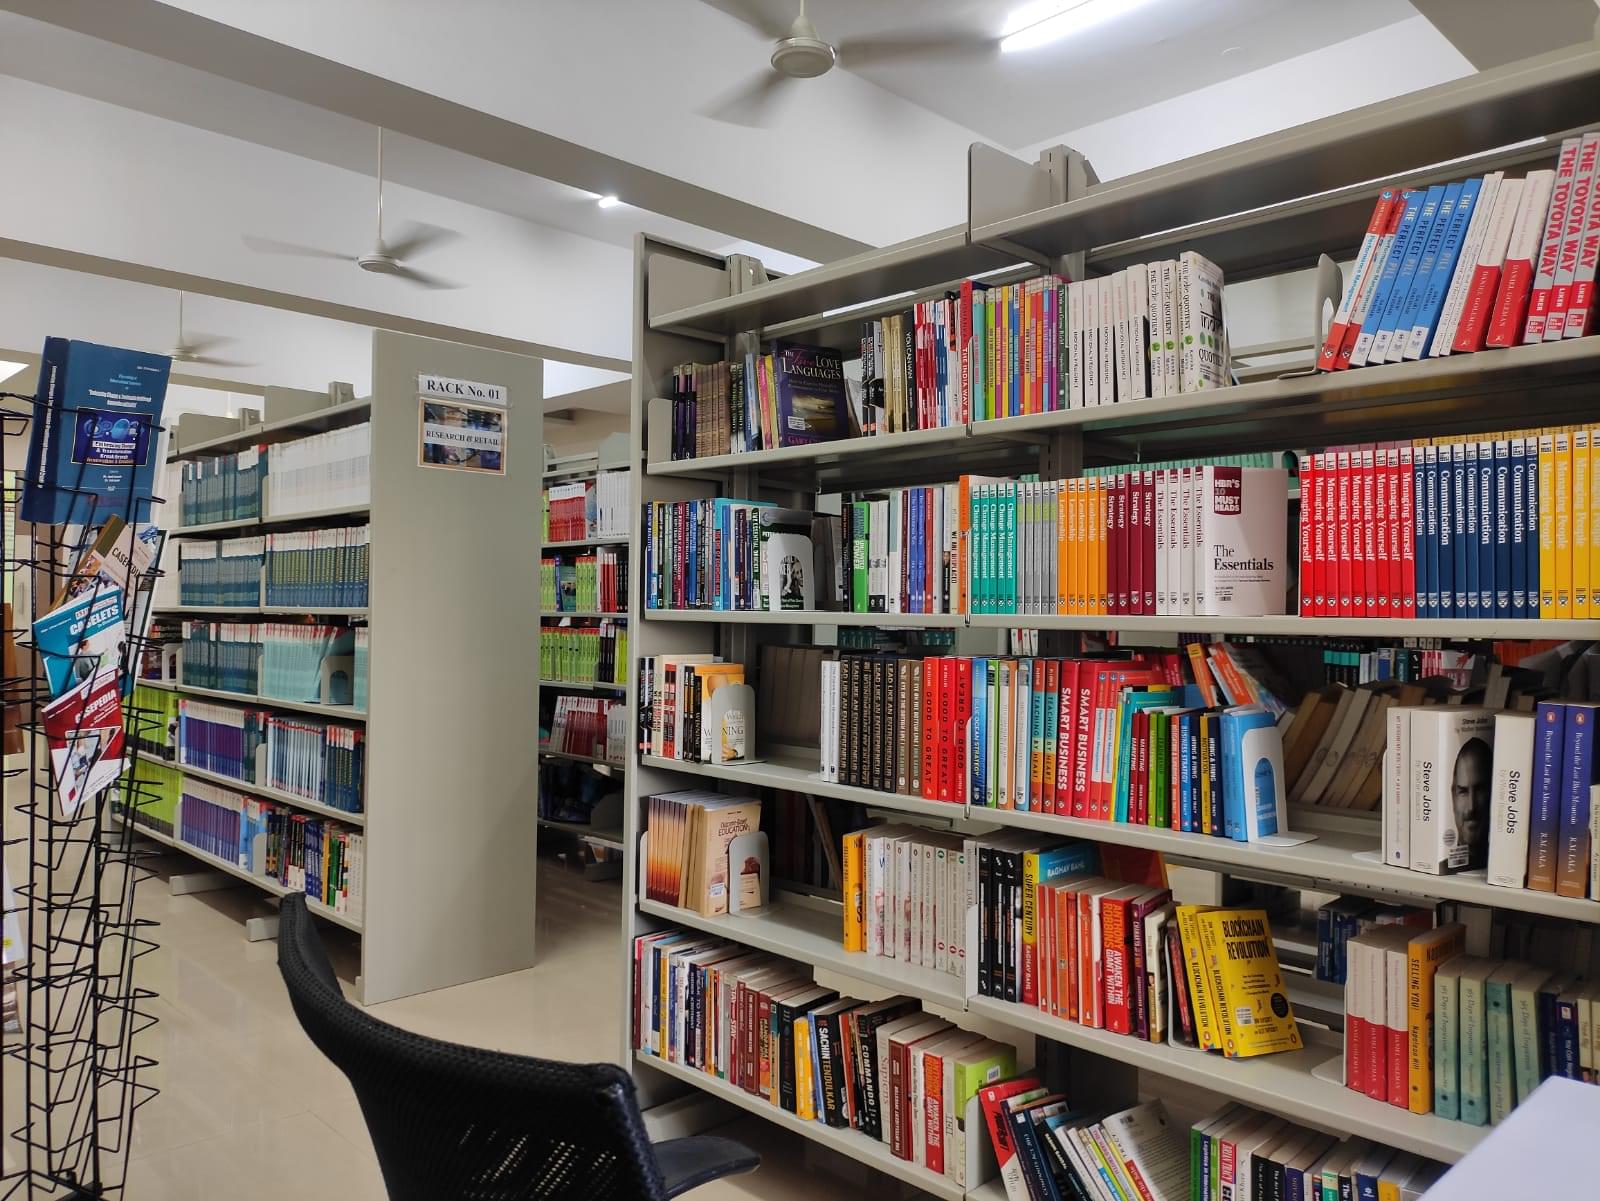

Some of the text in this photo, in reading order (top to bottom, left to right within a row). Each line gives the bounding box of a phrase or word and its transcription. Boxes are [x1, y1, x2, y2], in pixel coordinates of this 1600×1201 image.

[1405, 206, 1417, 221] THE
[1423, 202, 1435, 217] THE
[1459, 194, 1472, 209] THE
[1541, 147, 1577, 277] THE TOYOTA WAY
[1561, 141, 1597, 273] THE TOYOTA WAY
[1391, 224, 1411, 260] PERFECT
[1410, 220, 1429, 256] PERFECT
[1445, 213, 1464, 249] PERFECT
[1581, 235, 1599, 268] WAY
[783, 357, 841, 380] LANGUAGES
[815, 355, 840, 370] LOVE
[427, 380, 500, 399] RACK No. 01
[426, 430, 465, 441] RESEARCH
[1214, 479, 1240, 488] HBR'S
[1215, 496, 1240, 504] MUST
[1467, 468, 1476, 534] Communication
[1528, 463, 1537, 531] Communication
[1131, 491, 1139, 526] Strategy
[1144, 491, 1152, 527] Strategy
[1195, 487, 1203, 547] The Essentials
[1302, 479, 1311, 562] Managing Yourself
[1326, 478, 1336, 561] Managing Yourself
[1352, 475, 1362, 560] Managing Yourself
[1376, 474, 1387, 560] Managing Yourself
[1401, 472, 1412, 560] Managing Yourself
[1440, 470, 1450, 545] Communication
[1481, 467, 1491, 544] Communication
[1497, 466, 1508, 544] Communication
[1513, 465, 1524, 543] Communication
[1213, 545, 1234, 557] The
[1214, 558, 1274, 571] Essentials
[1057, 687, 1071, 790] SMART BUSINESS
[1075, 688, 1090, 792] SMART BUSINESS
[1422, 761, 1432, 821] Steve Jobs
[1506, 770, 1520, 834] Steve Jobs
[1025, 873, 1033, 897] SUPER
[1025, 900, 1033, 936] CENTURY
[1104, 903, 1114, 948] ROBBINS
[1113, 905, 1123, 950] ANTHONY
[1222, 919, 1265, 938] BLOCKCHAIN
[1226, 941, 1271, 960] REVOLUTION
[1107, 975, 1115, 1004] WITHIN
[1113, 951, 1123, 1005] AWAKEN THE
[1411, 958, 1420, 990] SELLING
[1411, 1025, 1419, 1057] Napoleon
[819, 1027, 835, 1111] SACHIN TENDULKAR
[861, 1045, 875, 1106] COMMANDO
